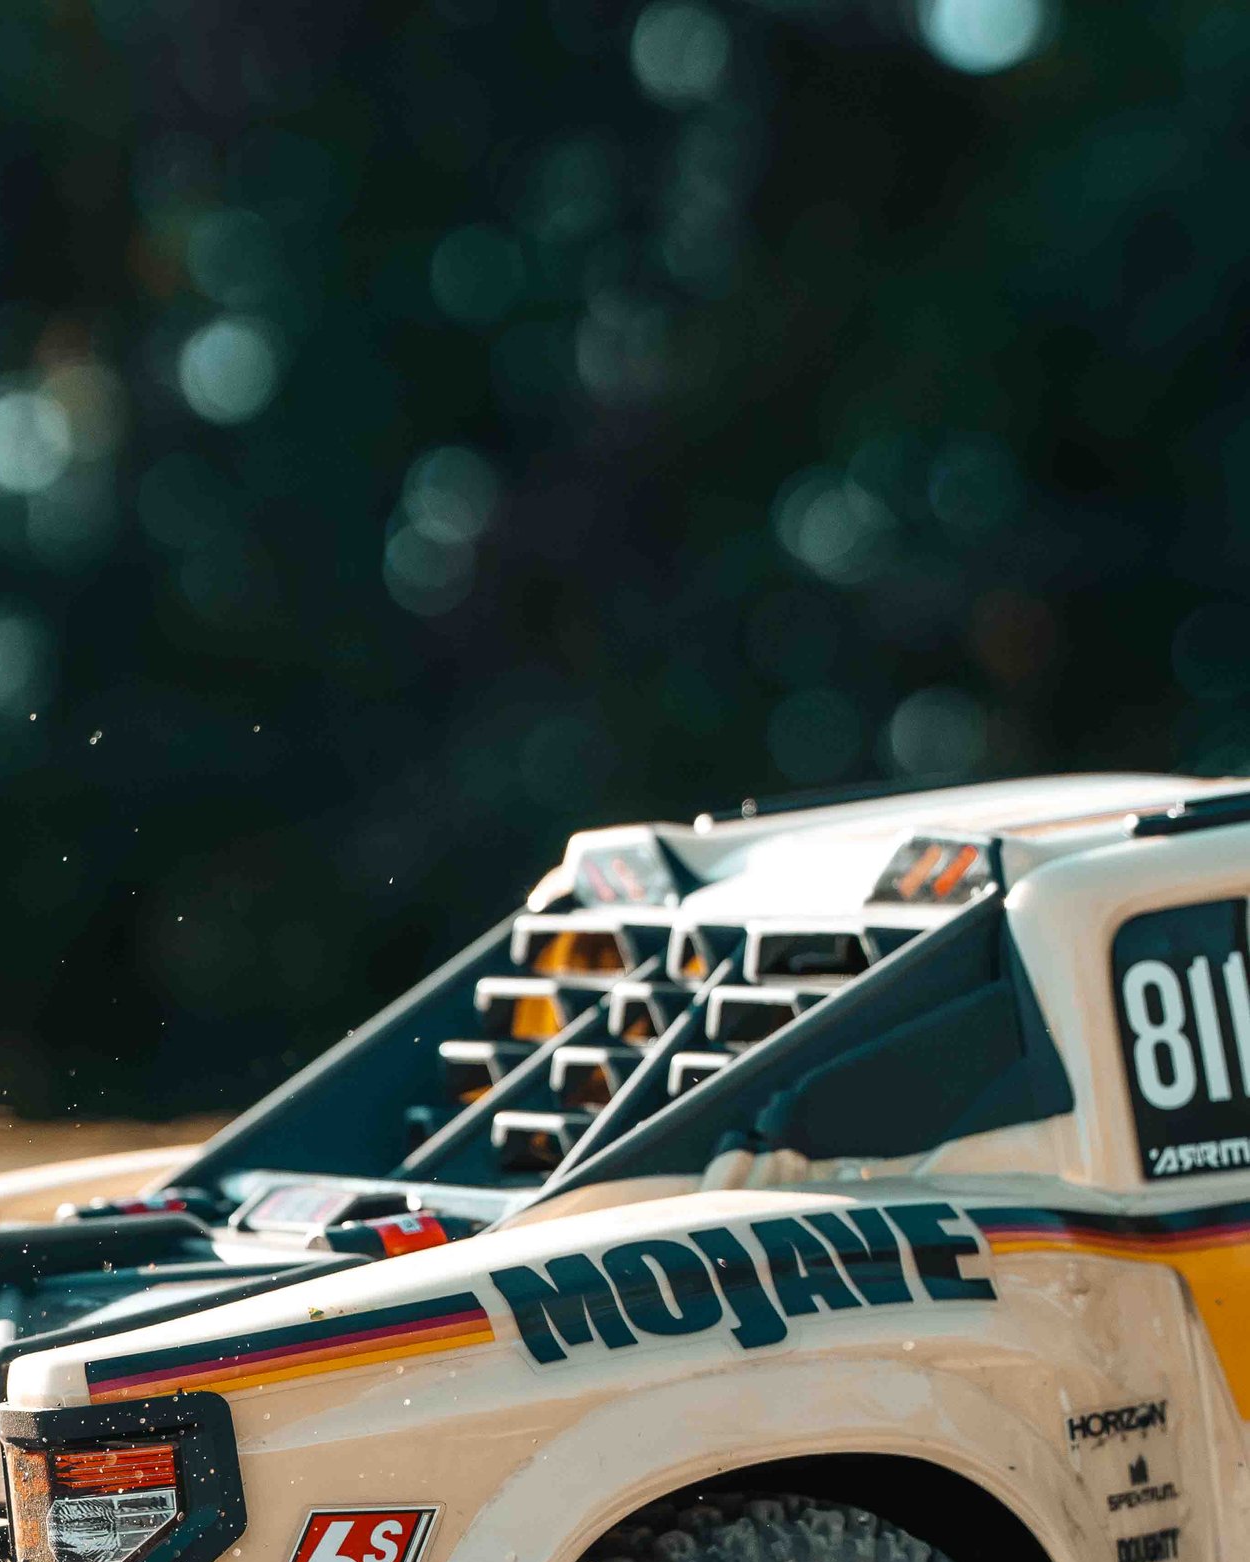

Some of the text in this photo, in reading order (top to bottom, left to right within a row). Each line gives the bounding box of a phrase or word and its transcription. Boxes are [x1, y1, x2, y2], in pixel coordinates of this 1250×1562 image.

[1122, 950, 1250, 1110] 811
[1149, 1136, 1250, 1175] ARRM
[489, 1202, 998, 1364] MOJAVE
